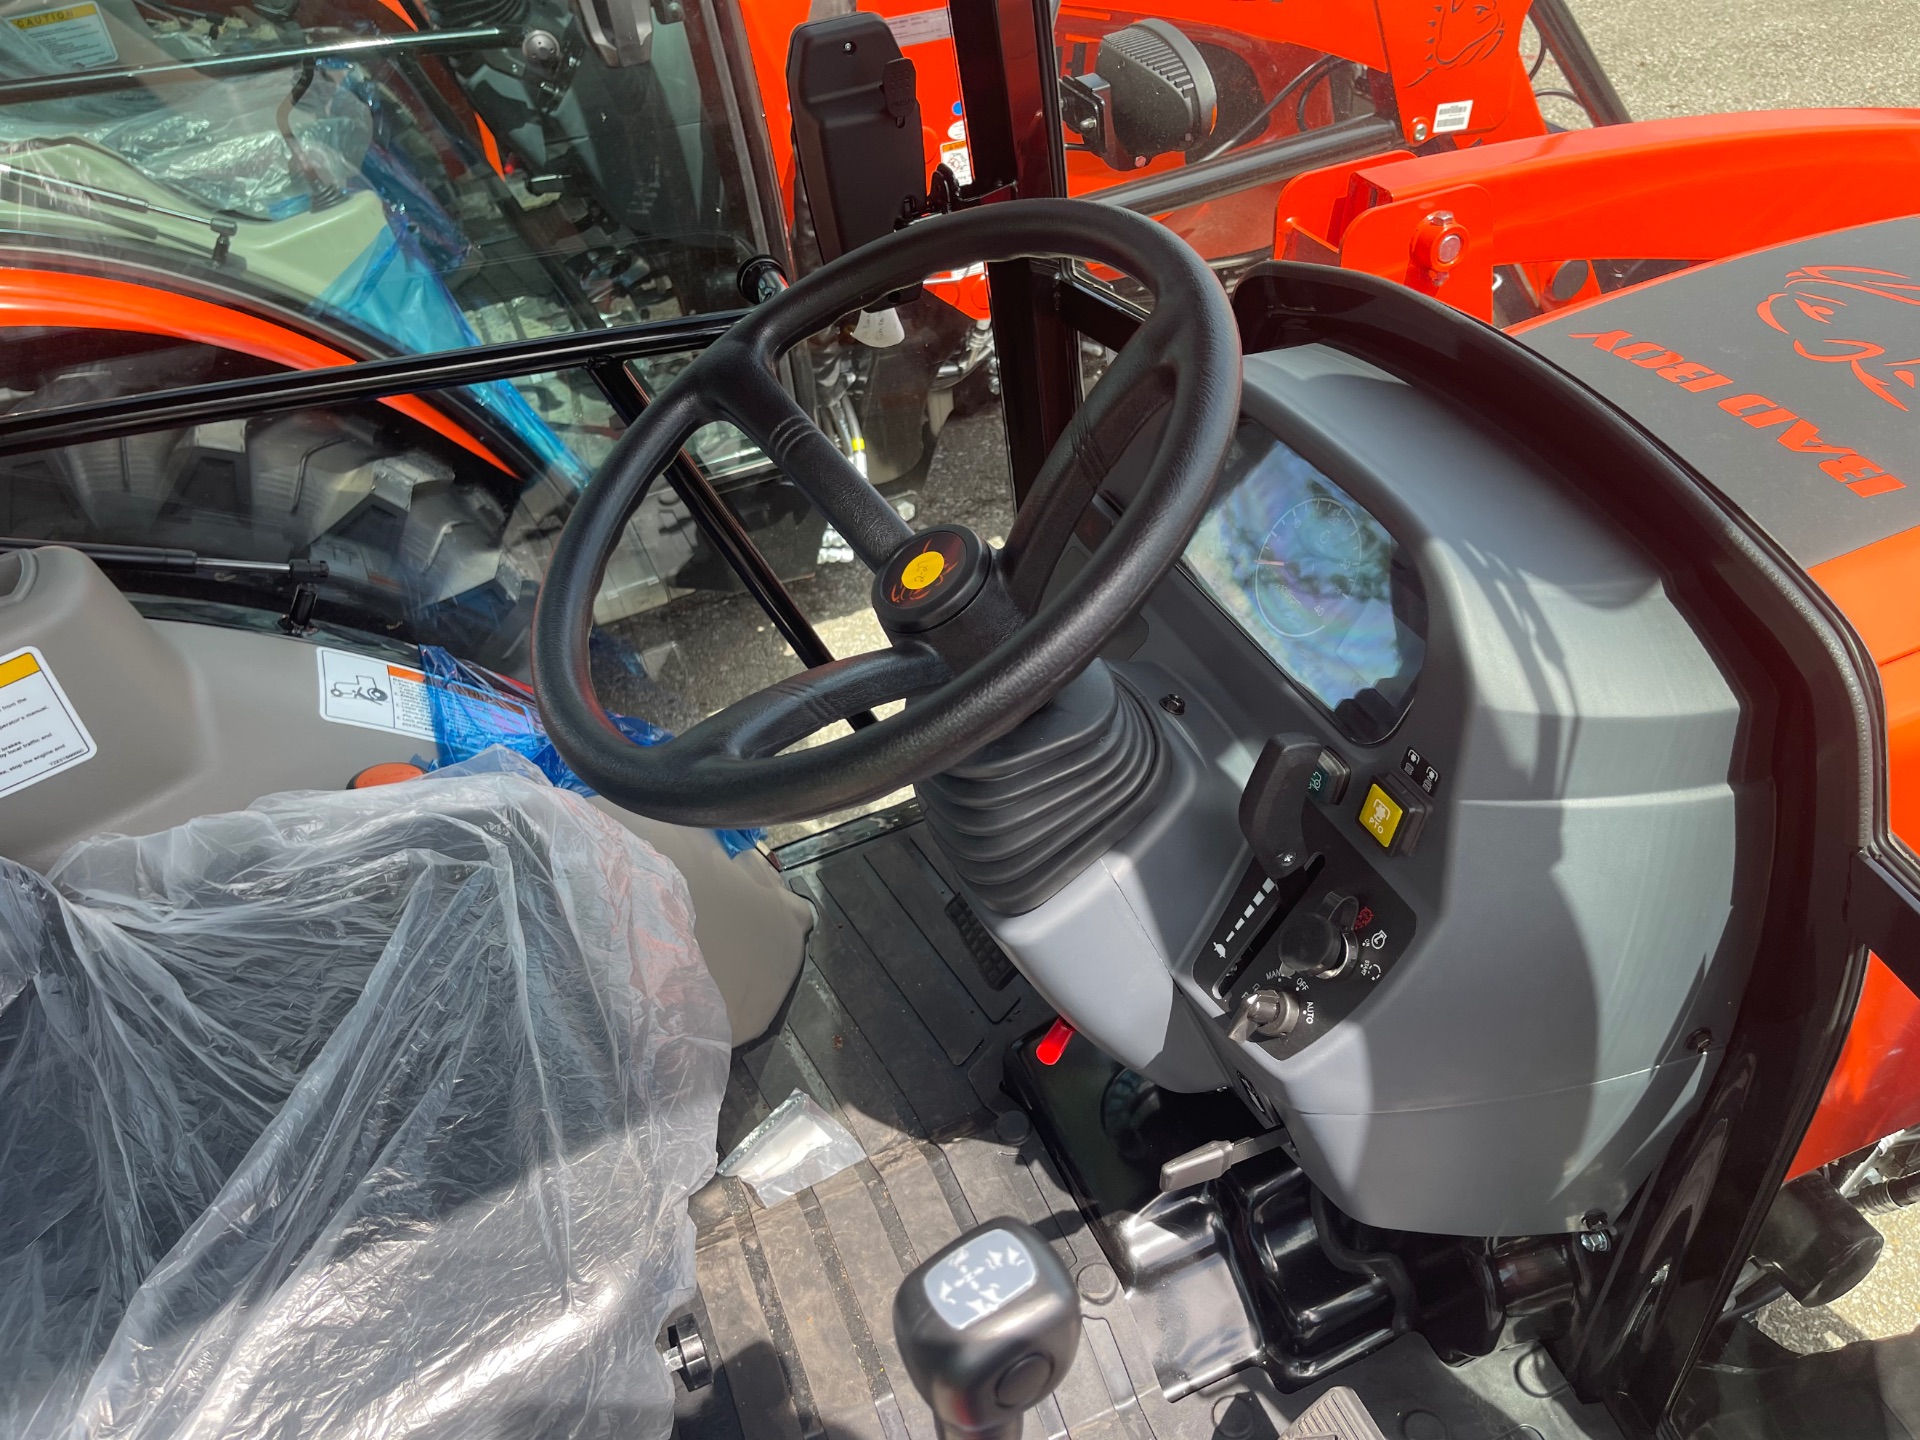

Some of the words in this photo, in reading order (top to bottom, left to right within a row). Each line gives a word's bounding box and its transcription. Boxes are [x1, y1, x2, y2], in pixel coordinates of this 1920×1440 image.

[16, 11, 75, 28] CAUTION
[1568, 329, 1735, 393] BOY
[1718, 393, 1907, 498] BAD
[41, 732, 52, 740] and
[54, 743, 65, 751] and
[1368, 816, 1384, 834] PTO
[1296, 977, 1309, 991] OFF
[1305, 1001, 1314, 1025] AUTO
